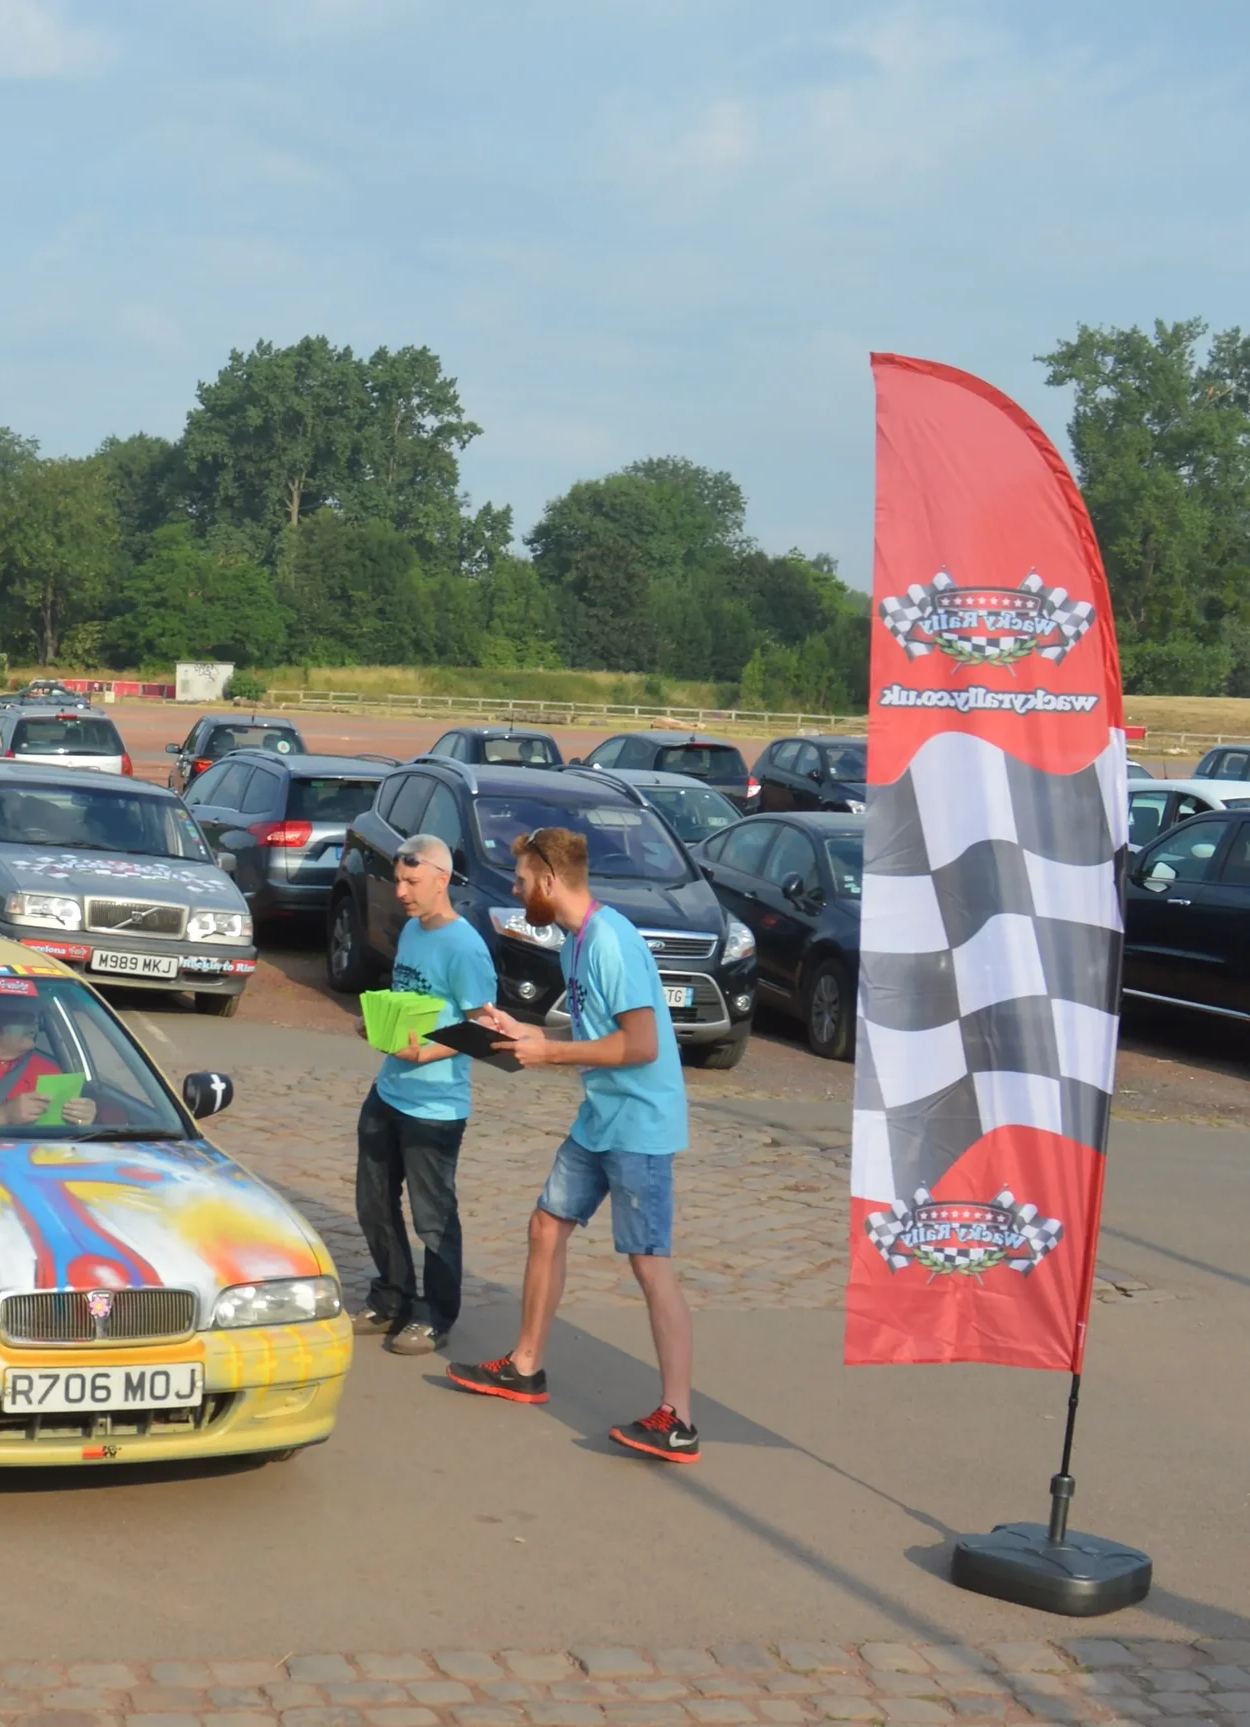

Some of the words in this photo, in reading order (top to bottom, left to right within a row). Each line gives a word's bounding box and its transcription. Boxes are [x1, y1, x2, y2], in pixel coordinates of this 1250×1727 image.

[98, 953, 138, 971] M989
[142, 957, 172, 974] MKJ
[10, 1372, 111, 1405] R706
[124, 1368, 196, 1403] MOJ
